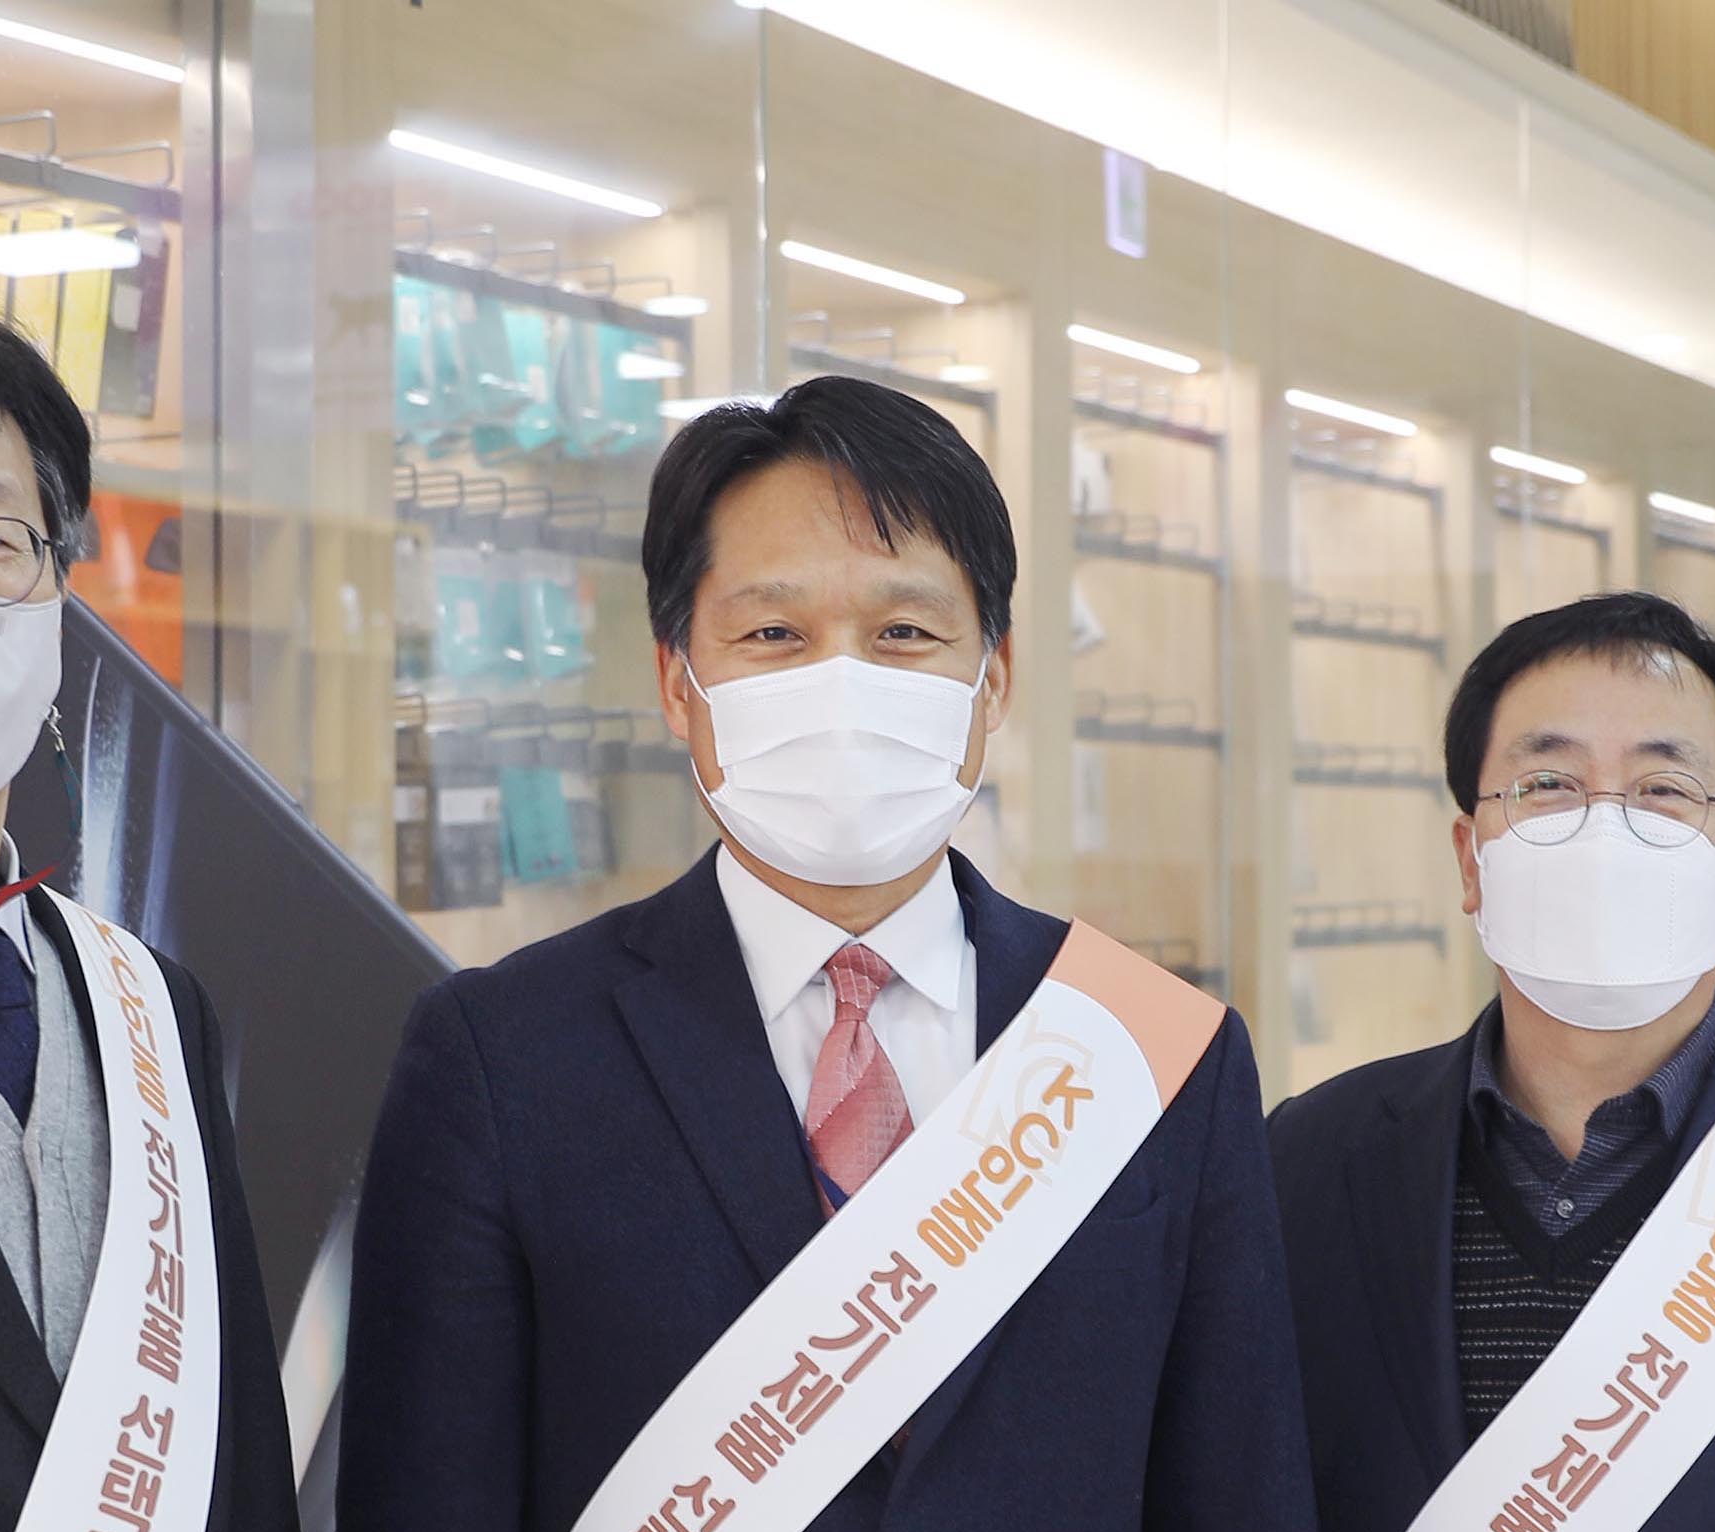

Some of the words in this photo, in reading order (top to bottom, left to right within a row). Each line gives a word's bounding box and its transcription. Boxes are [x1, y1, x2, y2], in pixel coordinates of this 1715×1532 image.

[136, 1118, 185, 1385] 전기제품
[914, 1062, 1096, 1270] KC인증
[713, 1250, 938, 1485] 전기제품
